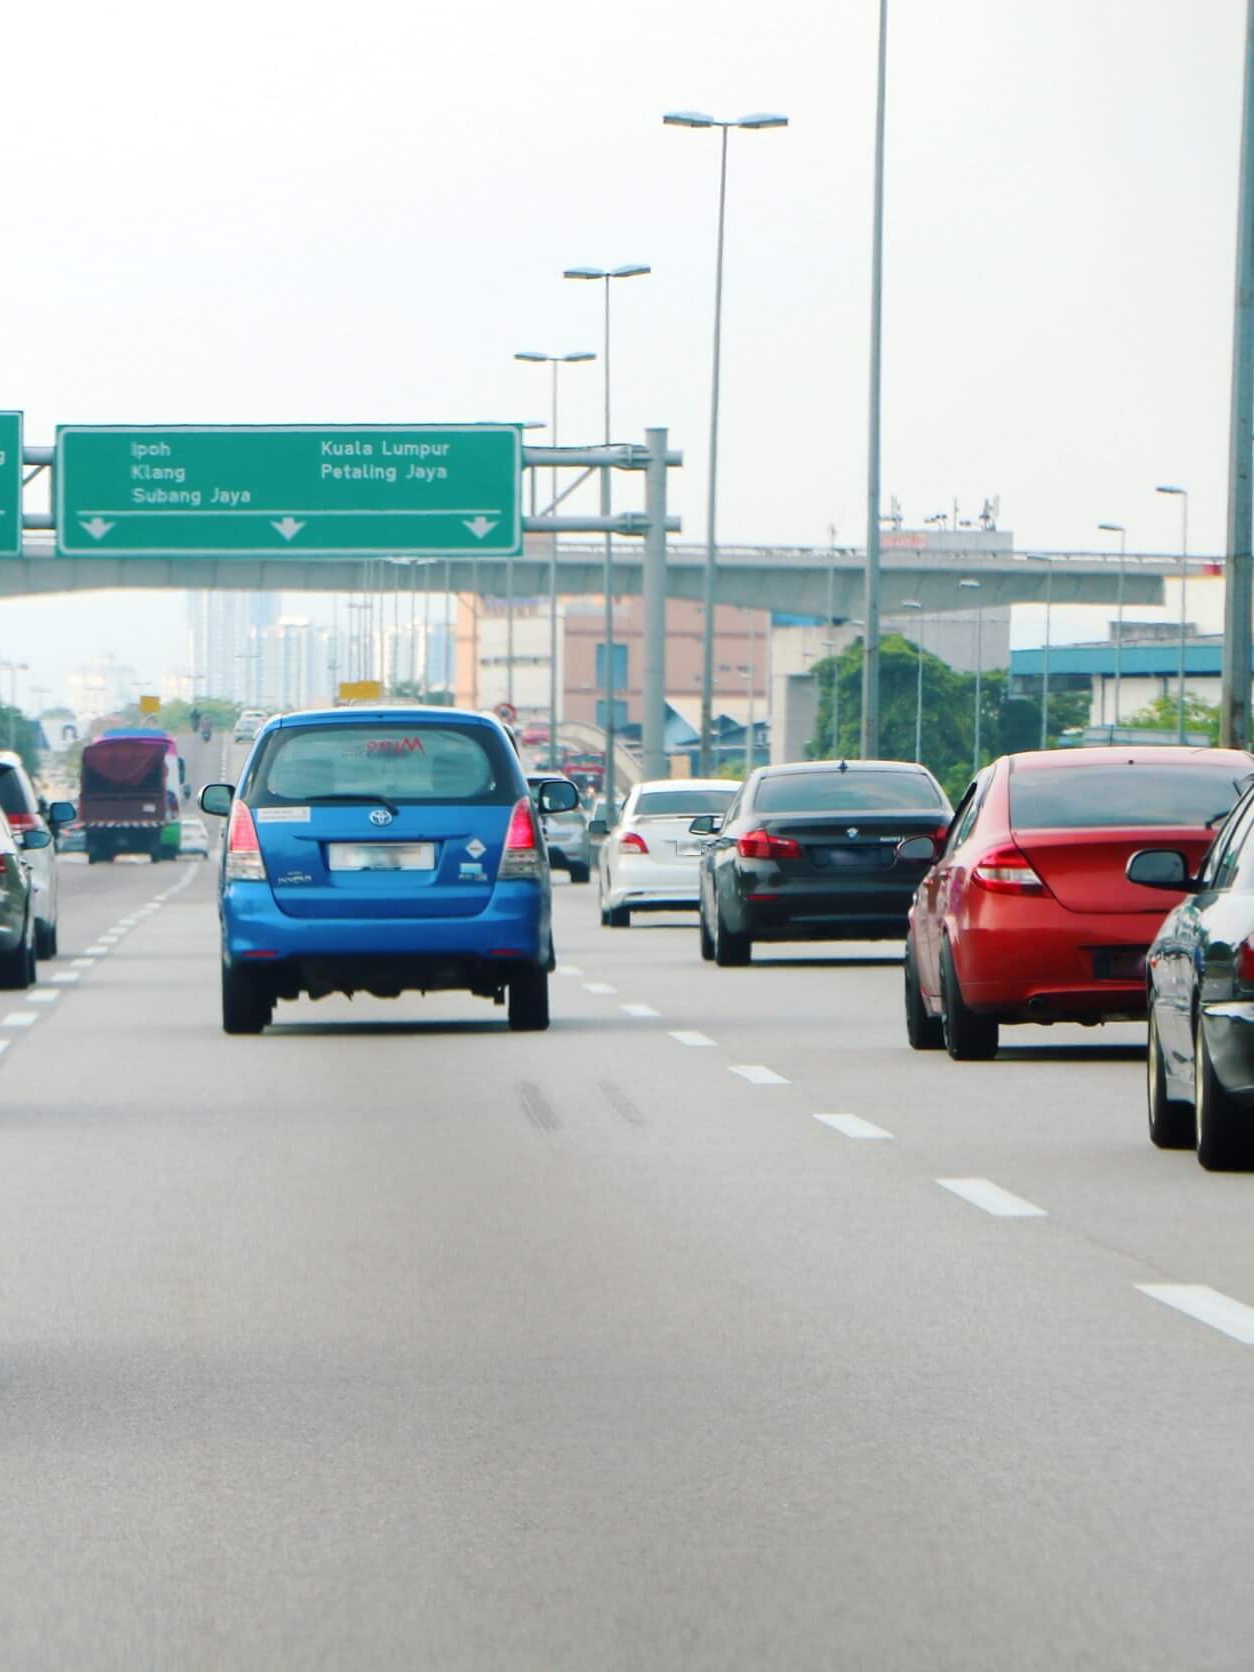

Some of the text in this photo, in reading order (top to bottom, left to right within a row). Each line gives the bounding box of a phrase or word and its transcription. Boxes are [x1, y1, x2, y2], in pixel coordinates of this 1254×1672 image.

[131, 441, 170, 459] Ipoh
[321, 441, 450, 459] Kuala Lumpur
[131, 464, 186, 482] Klang
[321, 464, 447, 482] Petaling Jaya
[132, 488, 251, 506] Subang Jaya
